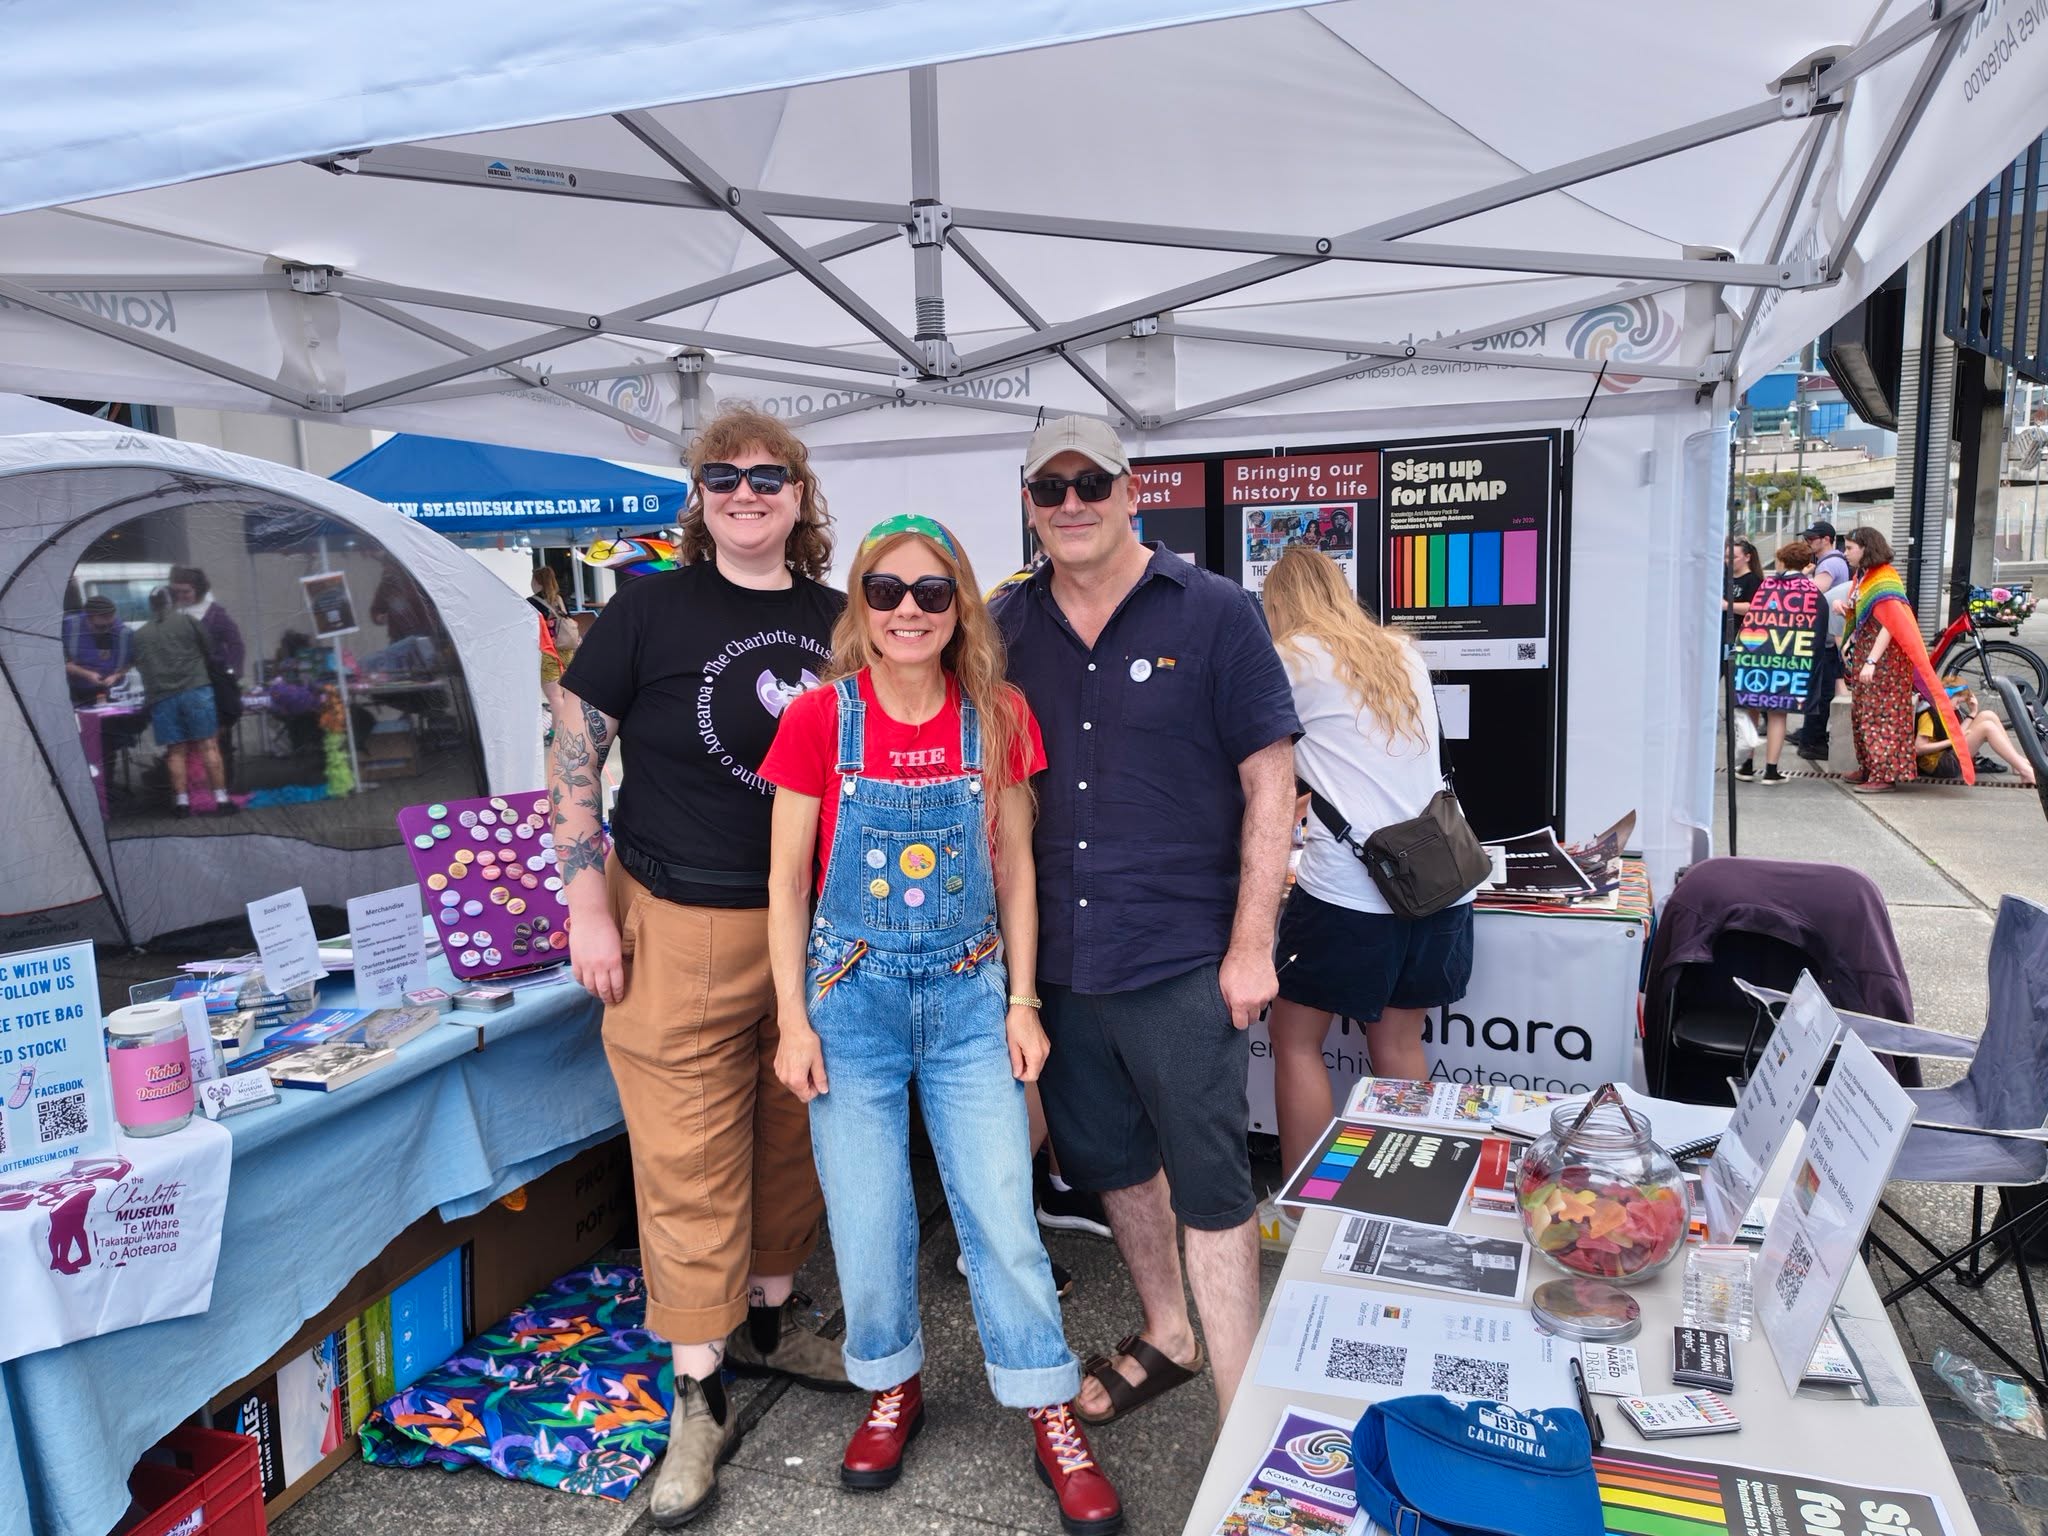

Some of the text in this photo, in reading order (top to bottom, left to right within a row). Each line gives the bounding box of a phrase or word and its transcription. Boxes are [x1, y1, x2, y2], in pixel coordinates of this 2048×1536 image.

[1237, 462, 1364, 482] Bringing our
[1391, 458, 1483, 483] Sign up
[1232, 479, 1368, 501] history to life
[1391, 480, 1507, 506] for KAMP
[1407, 516, 1429, 524] History
[703, 653, 731, 676] The
[725, 629, 797, 657] Charlotte
[697, 686, 726, 754] Aotearoa
[889, 747, 946, 767] THE
[366, 901, 404, 916] Merchandise
[13, 956, 71, 980] WITH US
[57, 974, 75, 991] US
[17, 1009, 51, 1030] TOTE
[55, 1004, 84, 1023] BAG
[18, 1037, 67, 1061] STOCK!
[146, 1062, 184, 1082] Koha
[34, 1078, 84, 1098] FACEBOOK
[137, 1077, 191, 1101] Donations
[1815, 1119, 1835, 1153] $10 each
[1409, 1135, 1443, 1169] KAMP
[1808, 1137, 1856, 1214] $7 goes to Kawe Mahara
[106, 1176, 187, 1213] the Charlotte
[115, 1203, 175, 1222] MUSEUM
[123, 1219, 180, 1235] Te Whare
[109, 1241, 177, 1261] o Aotearoa
[1355, 1300, 1368, 1326] Order Form
[1501, 1319, 1512, 1337] Friends
[1606, 1345, 1622, 1378] NAKED
[1699, 1331, 1712, 1372] are HUMAN
[1713, 1353, 1726, 1374] rights
[1582, 1350, 1603, 1380] DRAG
[1495, 1414, 1528, 1437] 1936
[262, 1401, 274, 1482] INSTANT SHELTER
[1467, 1425, 1547, 1458] CALIFORNIA
[1265, 1468, 1357, 1502] Kawe Mahara
[1756, 1500, 1773, 1528] History
